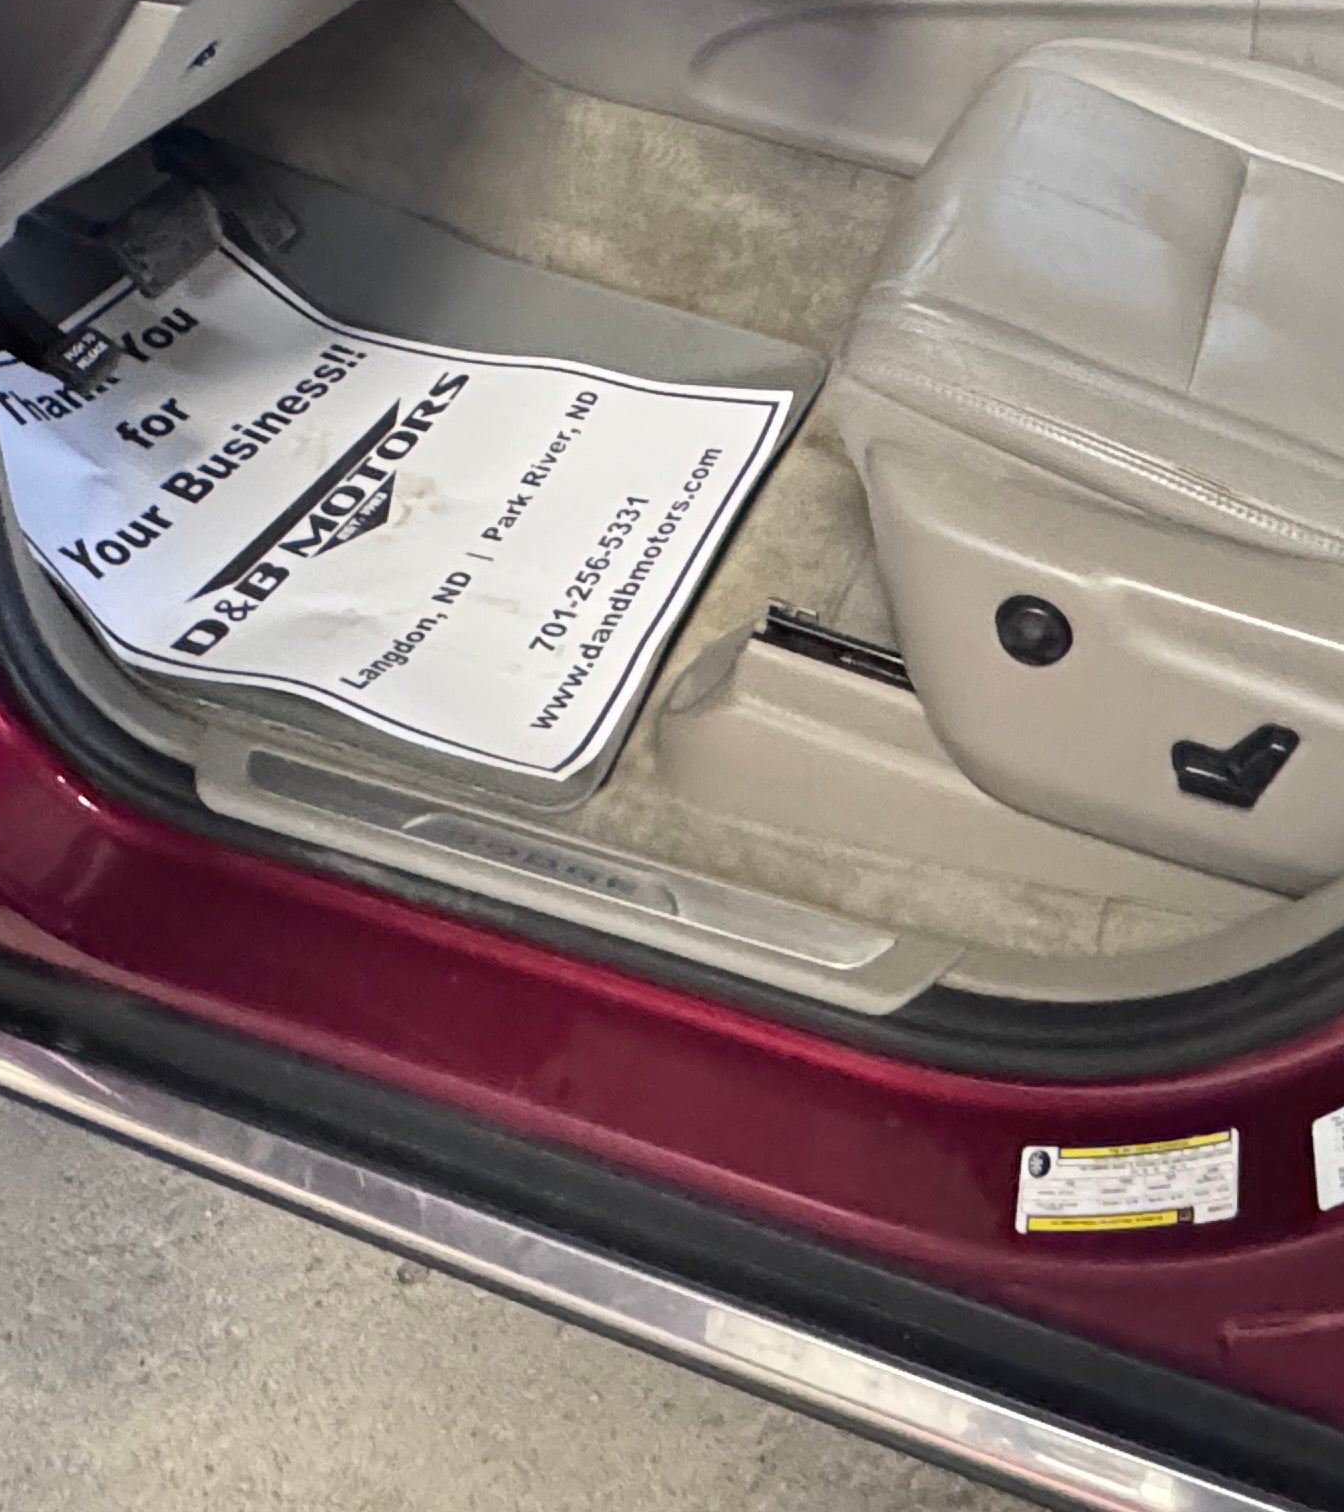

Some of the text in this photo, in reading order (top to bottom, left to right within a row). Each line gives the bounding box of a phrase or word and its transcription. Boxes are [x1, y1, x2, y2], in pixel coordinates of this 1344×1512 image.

[115, 397, 190, 449] for
[121, 307, 199, 363] You
[58, 343, 367, 579] Your Business!!
[169, 371, 471, 656] D&B MOTORS
[339, 607, 449, 690] Langdon,
[430, 570, 472, 605] ND
[480, 492, 534, 542] Park
[520, 427, 582, 488] River,
[565, 390, 598, 421] ND
[528, 495, 650, 652] 701-256-5331
[529, 447, 723, 730] www.dandbmotors.com
